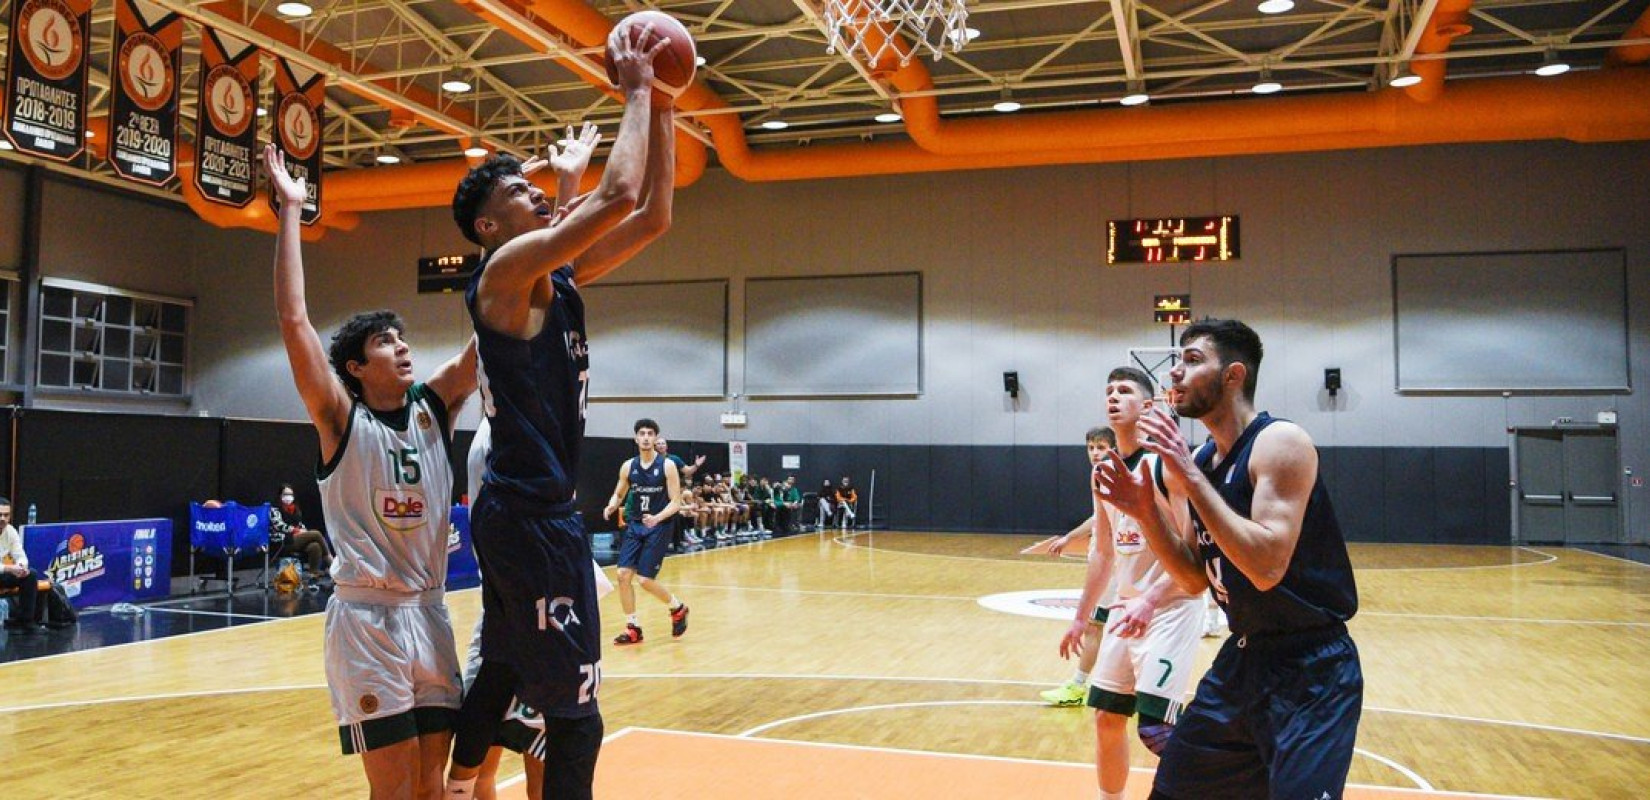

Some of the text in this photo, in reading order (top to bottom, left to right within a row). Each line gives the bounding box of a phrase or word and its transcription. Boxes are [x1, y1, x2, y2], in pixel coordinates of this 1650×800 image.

[15, 95, 76, 130] 2018-2019
[117, 125, 170, 157] 2019-2020
[202, 151, 250, 180] 2020-2021
[388, 448, 421, 484] 15
[384, 496, 423, 514] Dole
[55, 554, 103, 584] STARS
[1157, 658, 1172, 688] 7
